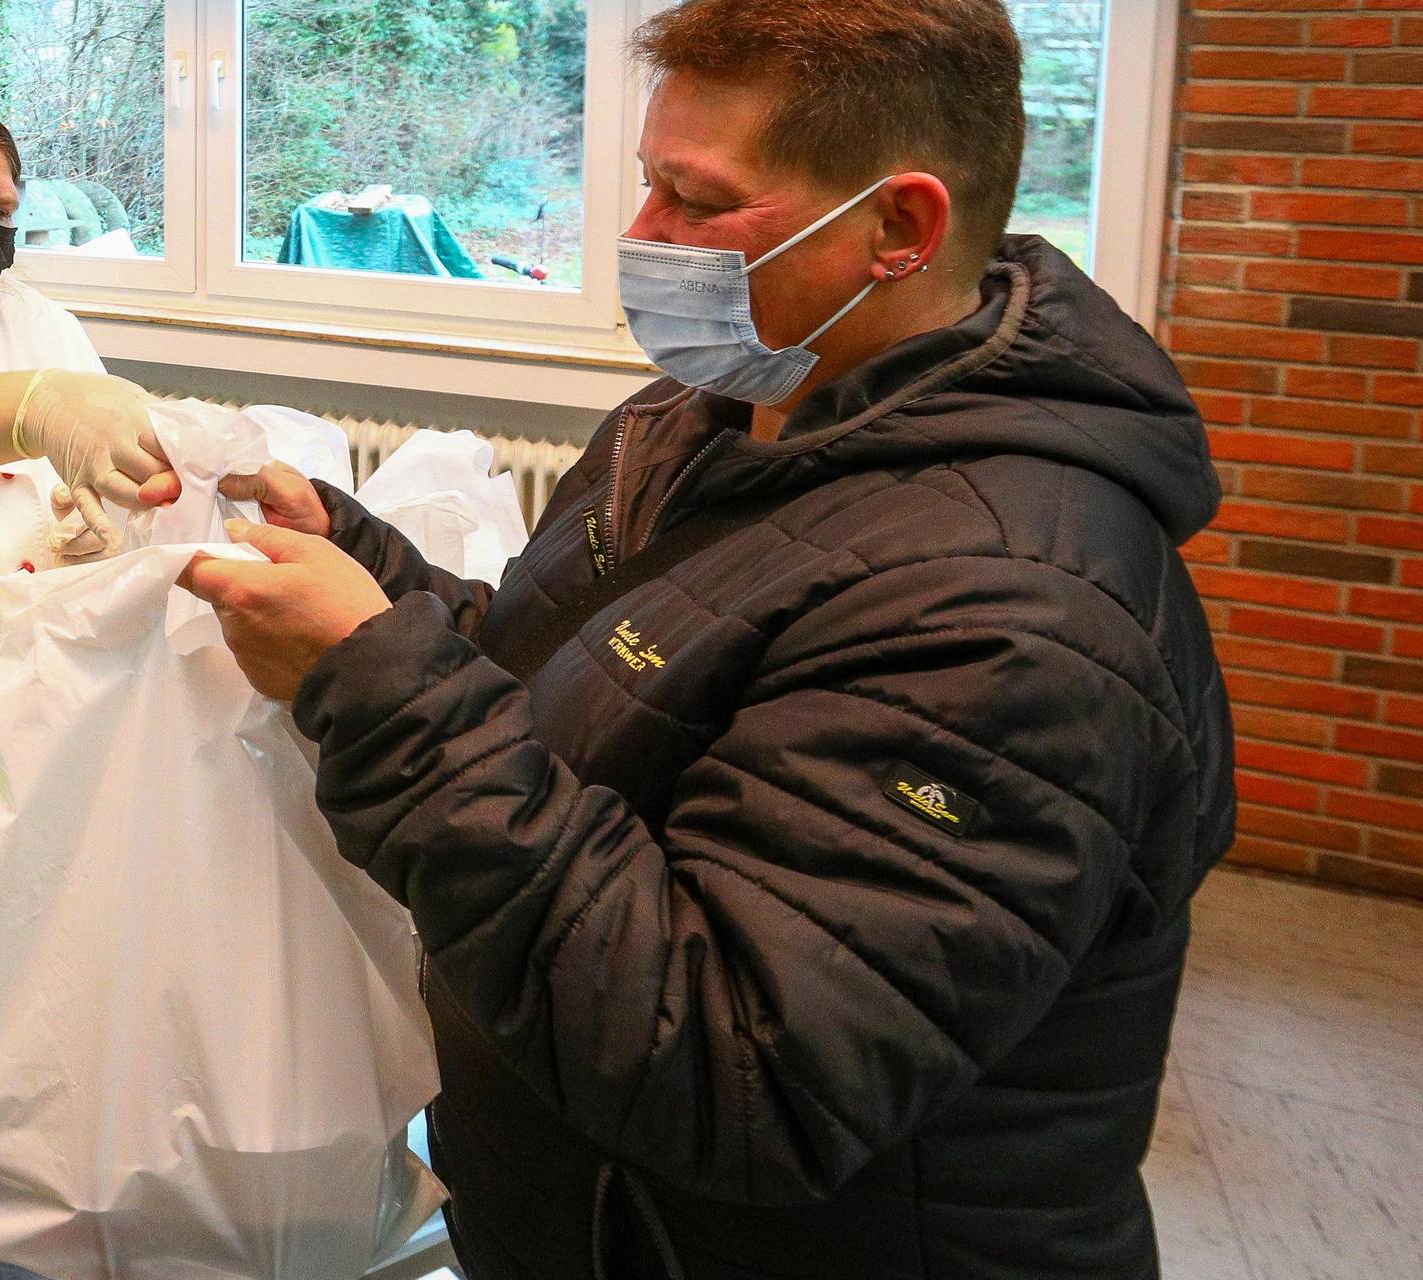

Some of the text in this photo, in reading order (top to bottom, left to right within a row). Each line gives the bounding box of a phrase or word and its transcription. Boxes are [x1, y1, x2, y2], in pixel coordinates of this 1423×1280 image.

[679, 280, 720, 293] ABENA
[586, 516, 599, 550] Uncle
[615, 620, 641, 646] Uncle
